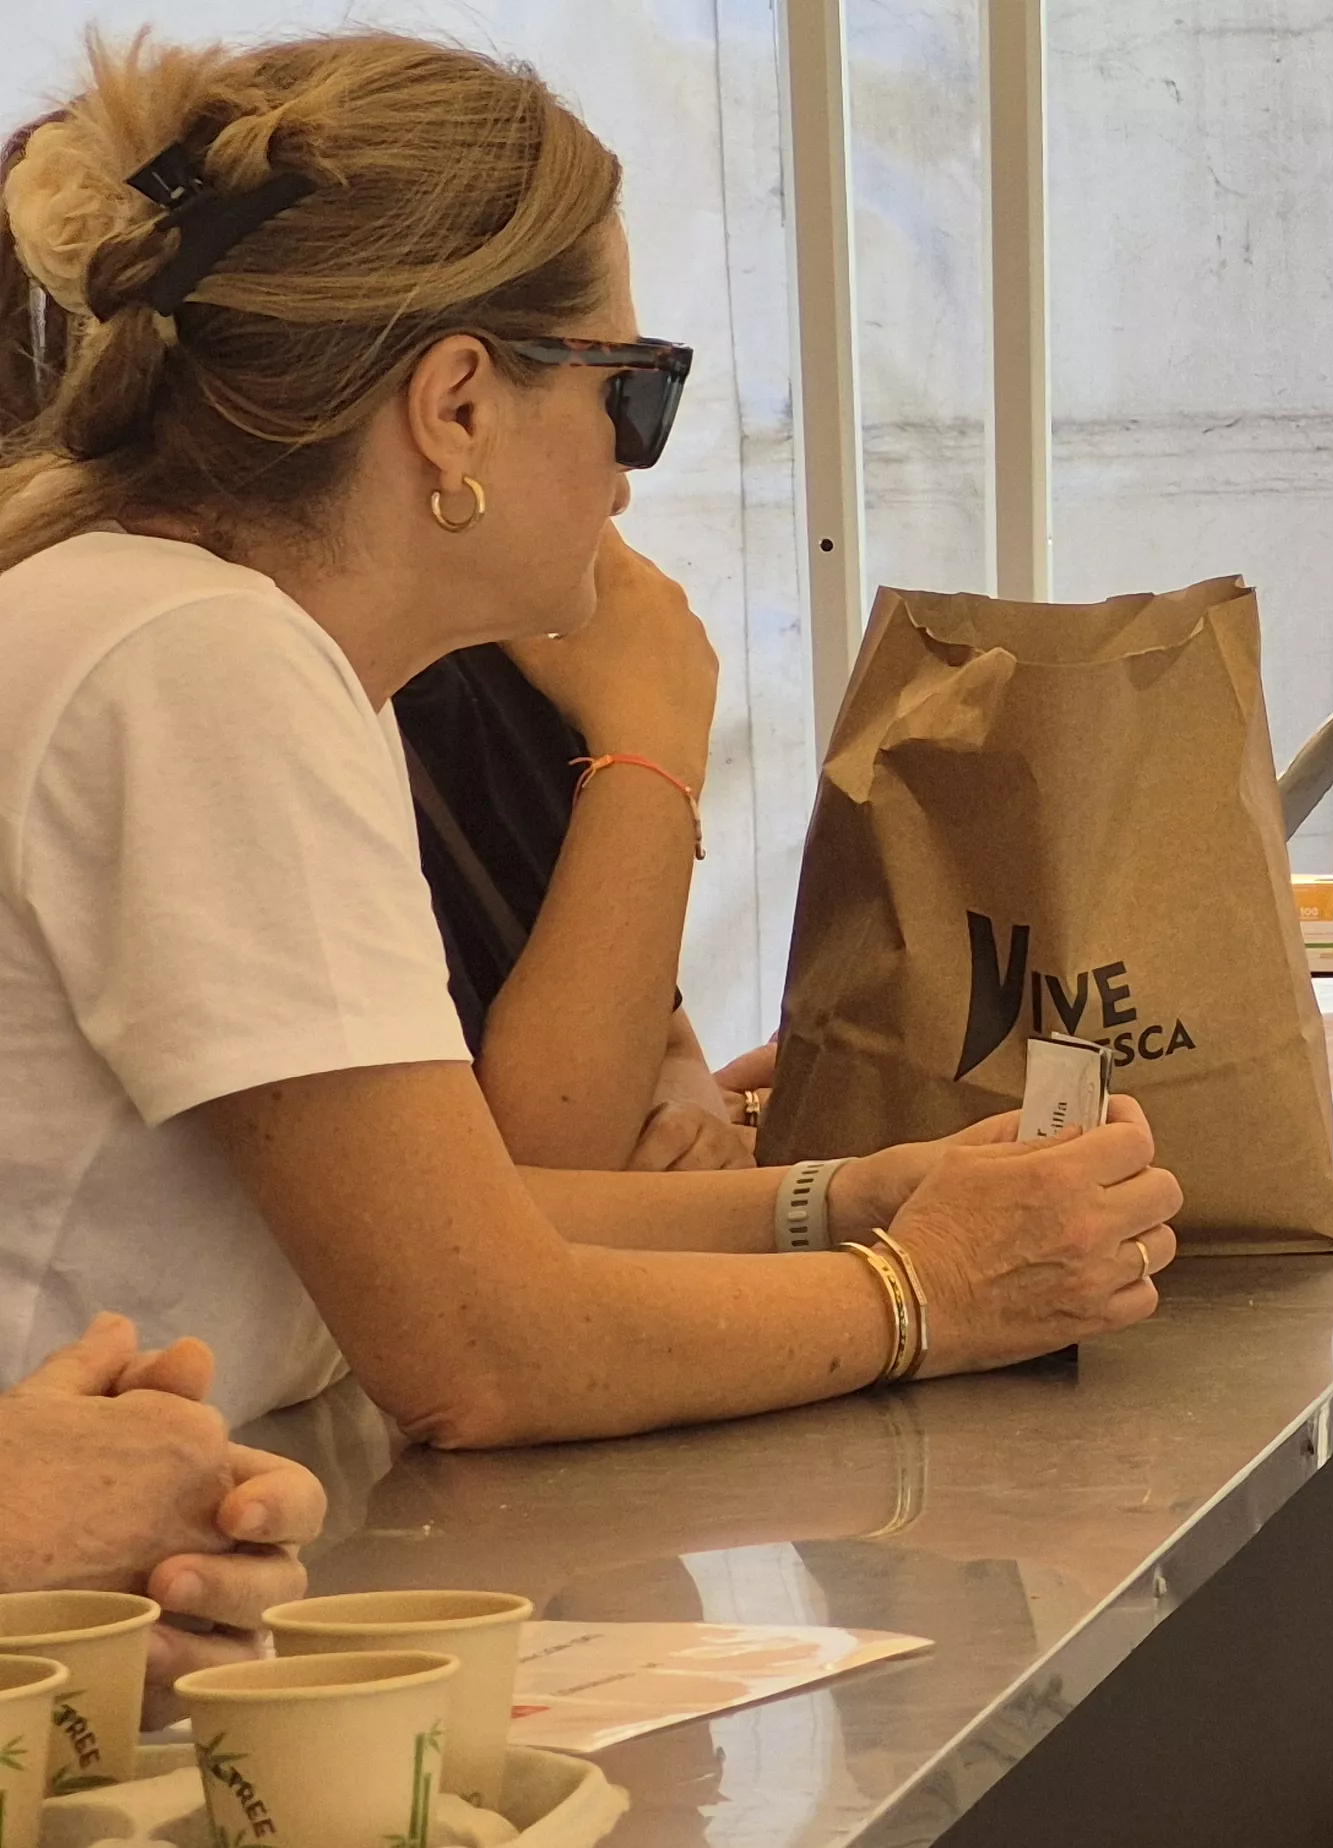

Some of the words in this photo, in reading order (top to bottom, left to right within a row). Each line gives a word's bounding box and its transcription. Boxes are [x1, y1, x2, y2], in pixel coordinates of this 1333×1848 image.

[954, 909, 1138, 1082] VIVE
[1094, 1017, 1197, 1068] SCA
[55, 1703, 101, 1770] TREE
[228, 1765, 277, 1839] TREE
